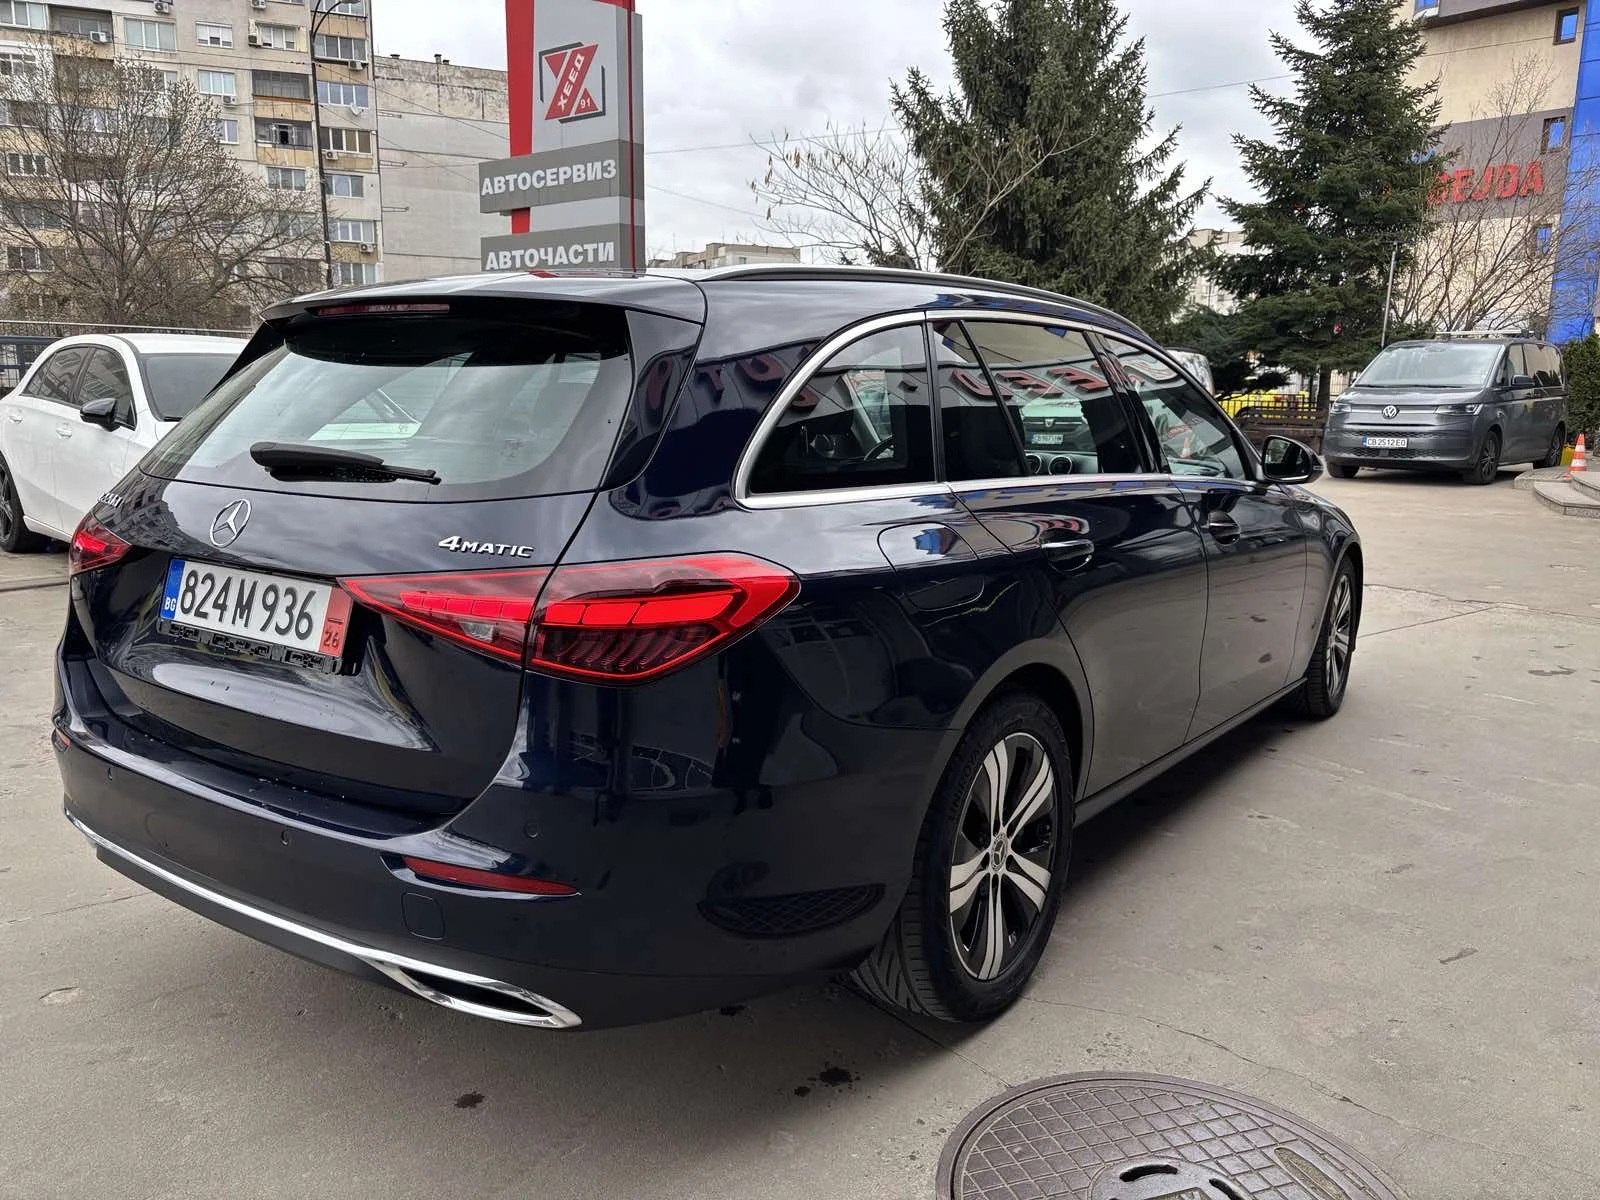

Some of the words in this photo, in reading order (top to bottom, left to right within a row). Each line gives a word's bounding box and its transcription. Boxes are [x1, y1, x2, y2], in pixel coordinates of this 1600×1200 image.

[580, 97, 591, 109] 91
[481, 159, 617, 196] АВТОСЕРВИЗ
[485, 241, 615, 271] АВТОЧАСТИ
[438, 535, 534, 558] 4MATIC
[164, 597, 176, 612] BG
[323, 630, 341, 648] 26
